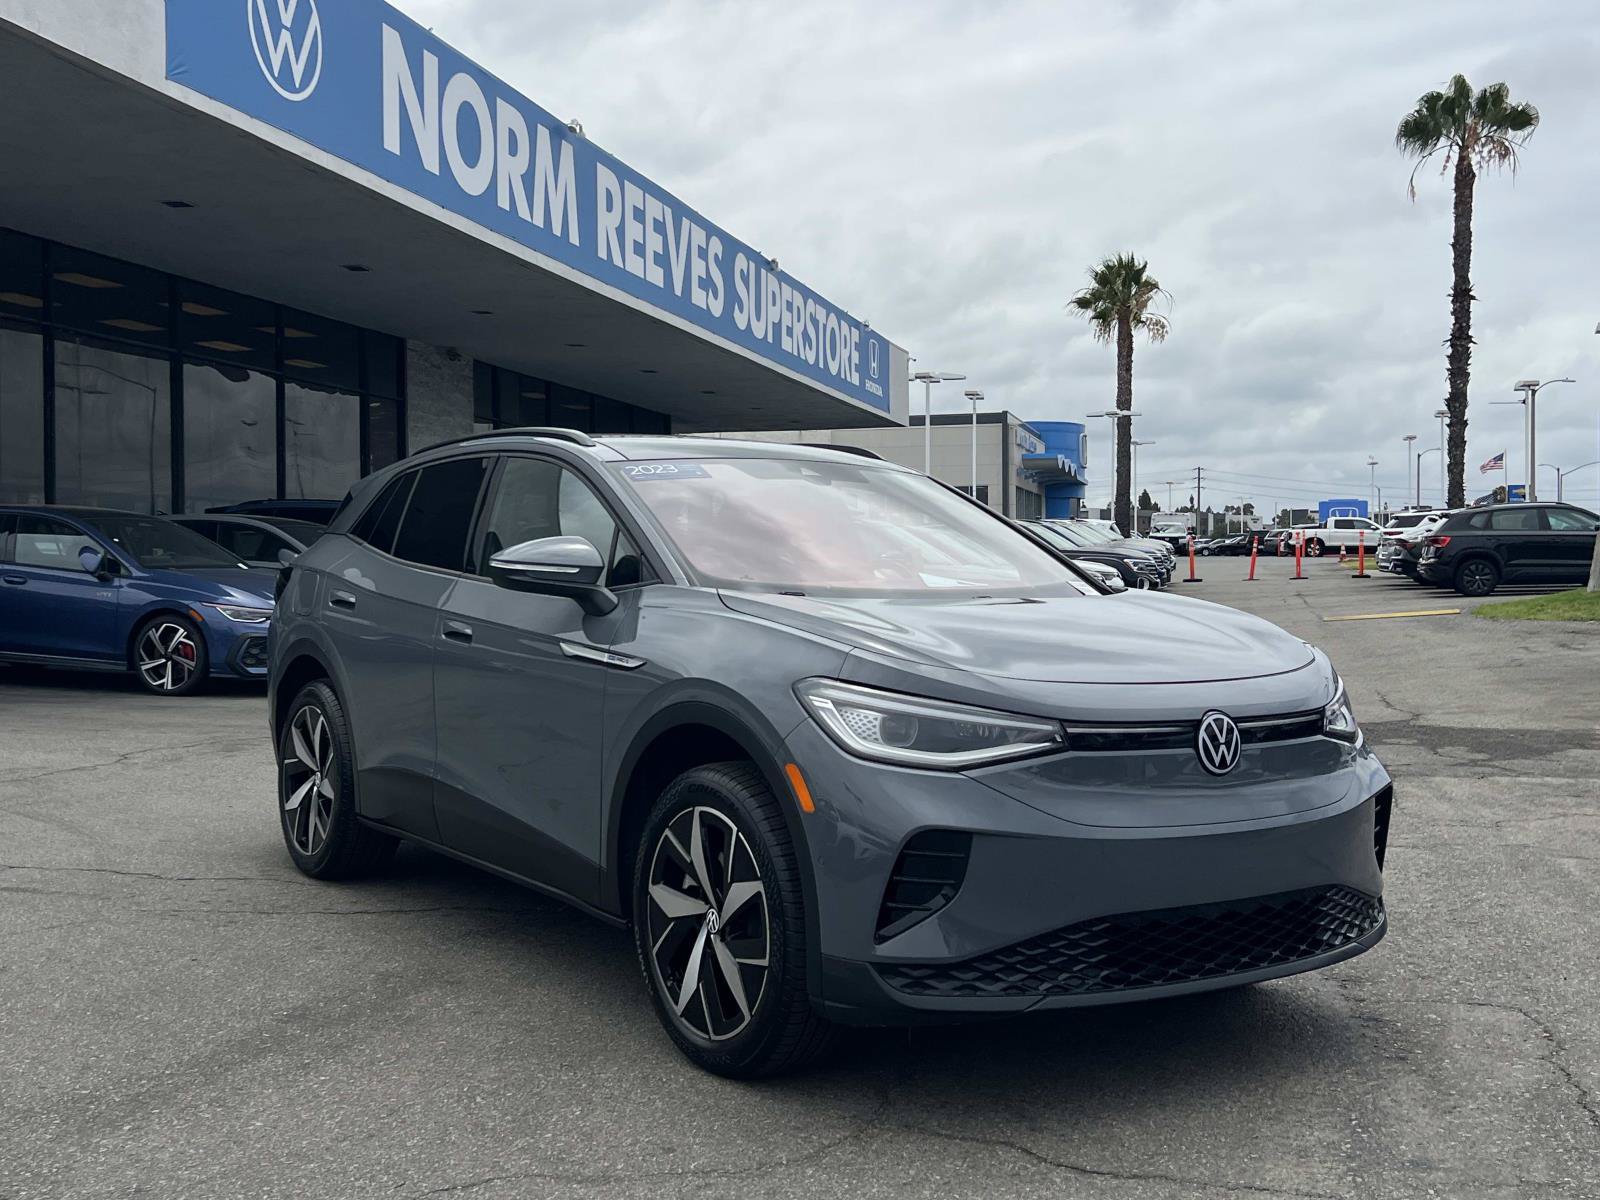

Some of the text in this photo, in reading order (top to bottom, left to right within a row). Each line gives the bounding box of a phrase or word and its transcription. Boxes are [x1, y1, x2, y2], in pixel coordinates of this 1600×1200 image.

[382, 22, 860, 386] NORM REEVES SUPERSTORE
[865, 378, 884, 397] HONDA
[624, 464, 679, 475] 2023
